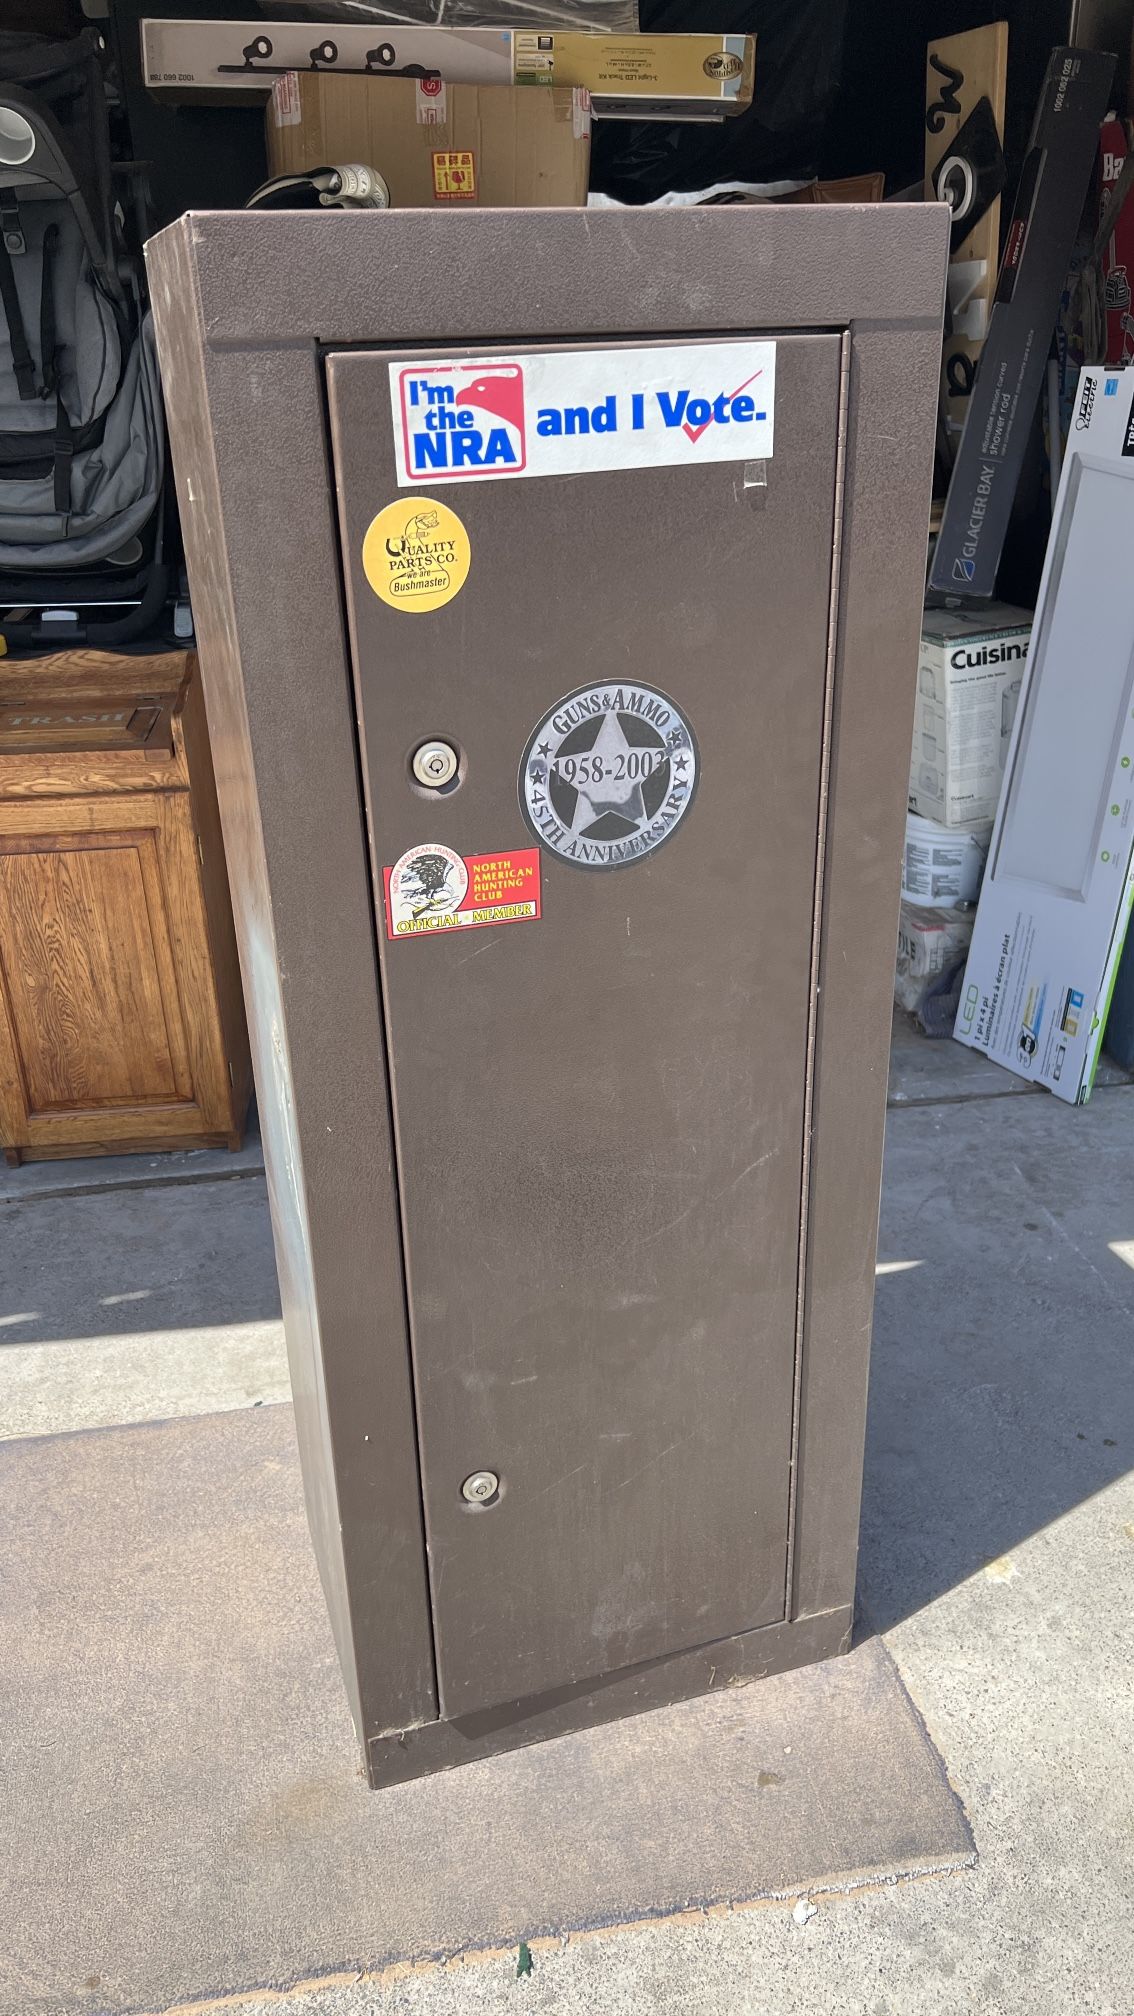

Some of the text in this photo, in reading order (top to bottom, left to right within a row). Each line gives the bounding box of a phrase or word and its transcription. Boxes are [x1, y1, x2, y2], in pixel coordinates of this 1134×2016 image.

[608, 73, 624, 81] Track
[1054, 92, 1065, 113] 1002
[1063, 58, 1073, 75] 025
[1102, 152, 1125, 181] Ba
[409, 380, 455, 406] I'm
[425, 405, 474, 429] the
[537, 390, 767, 436] and I Vote.
[989, 415, 1006, 456] shower
[1000, 393, 1011, 413] rod
[413, 428, 516, 469] NRA
[962, 464, 996, 558] GLACIER BAY
[385, 535, 456, 557] QUALITY
[389, 552, 459, 571] PARTS CO.
[406, 571, 418, 579] we
[394, 577, 447, 592] Bushmaster
[8, 713, 124, 726] TRASH
[552, 751, 668, 786] 1958-2003
[531, 777, 689, 862] 45TH ANNIVERSARY
[393, 869, 401, 893] NORTH
[399, 846, 432, 869] AMERICAN
[434, 846, 462, 869] HUNTING
[473, 860, 511, 873] NORTH
[473, 867, 533, 883] AMERICAN
[474, 878, 523, 893] HUNTING
[474, 892, 503, 902] CLUB
[396, 904, 532, 933] OFFICIAL MEMBER
[982, 993, 999, 1046] Luminaires
[996, 956, 1006, 984] écran
[1001, 933, 1011, 955] plat
[959, 984, 979, 1035] LED
